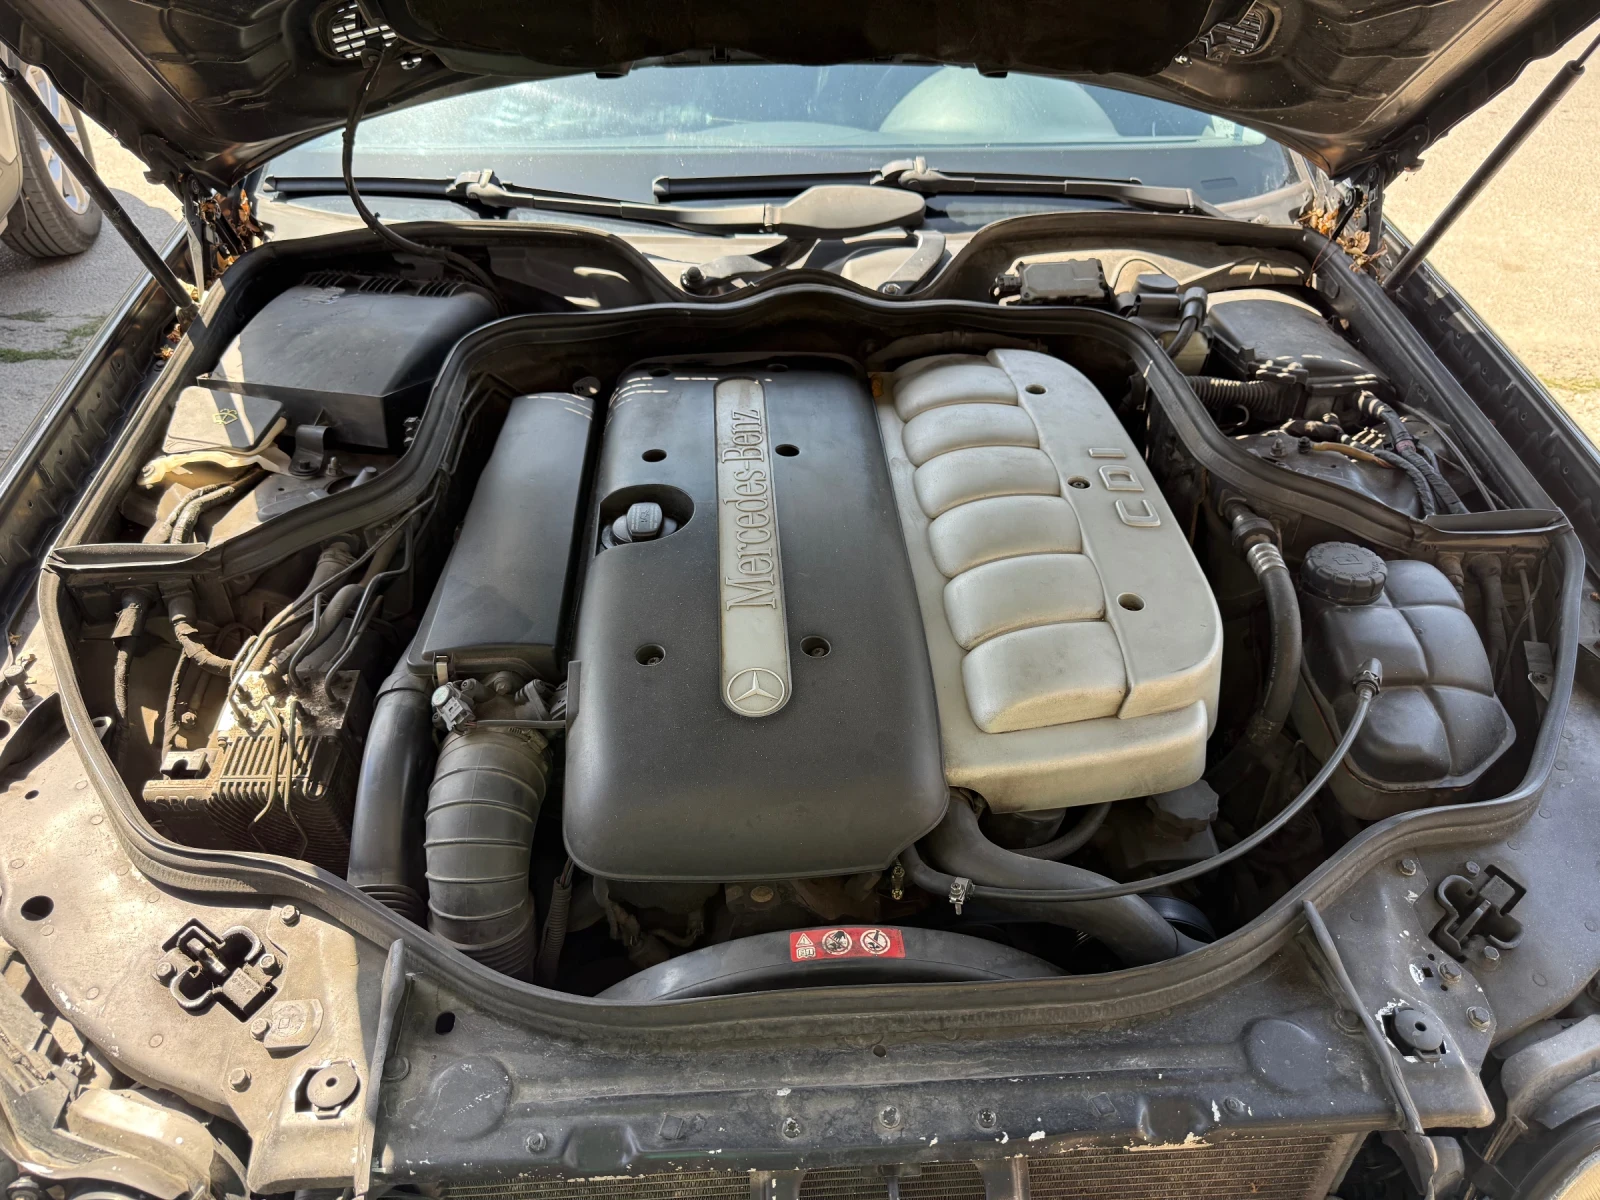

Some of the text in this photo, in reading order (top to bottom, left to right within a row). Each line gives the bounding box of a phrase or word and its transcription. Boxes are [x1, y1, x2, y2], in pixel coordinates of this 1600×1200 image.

[721, 409, 777, 610] Mercedes-Benz
[1089, 447, 1160, 527] CDI
[154, 795, 199, 811] SBC
